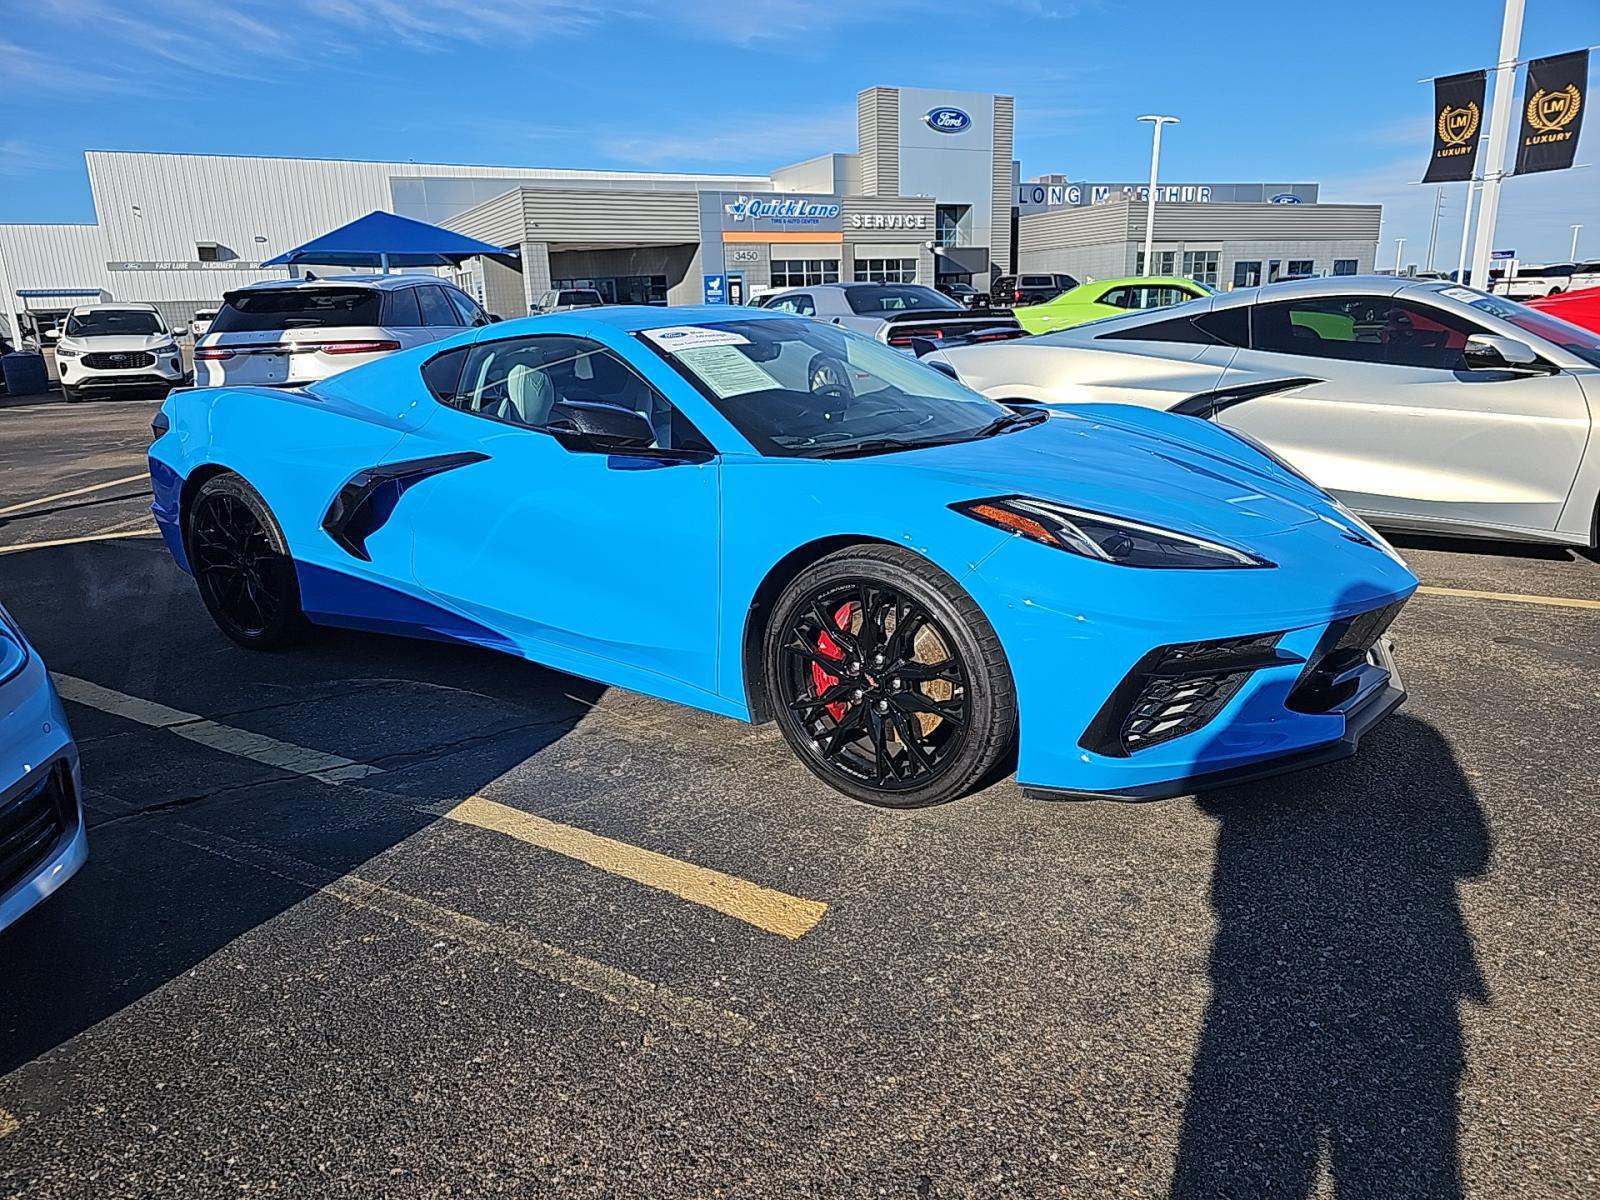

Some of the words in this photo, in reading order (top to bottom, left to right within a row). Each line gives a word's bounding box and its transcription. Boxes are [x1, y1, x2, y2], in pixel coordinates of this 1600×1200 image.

[1543, 99, 1564, 113] LM
[937, 112, 963, 126] Ford
[1450, 115, 1467, 128] LM
[1525, 132, 1572, 145] LUXURY
[1437, 145, 1472, 157] LUXURY
[1018, 187, 1081, 205] LONG
[851, 213, 926, 228] SERVICE
[735, 251, 758, 261] 3450
